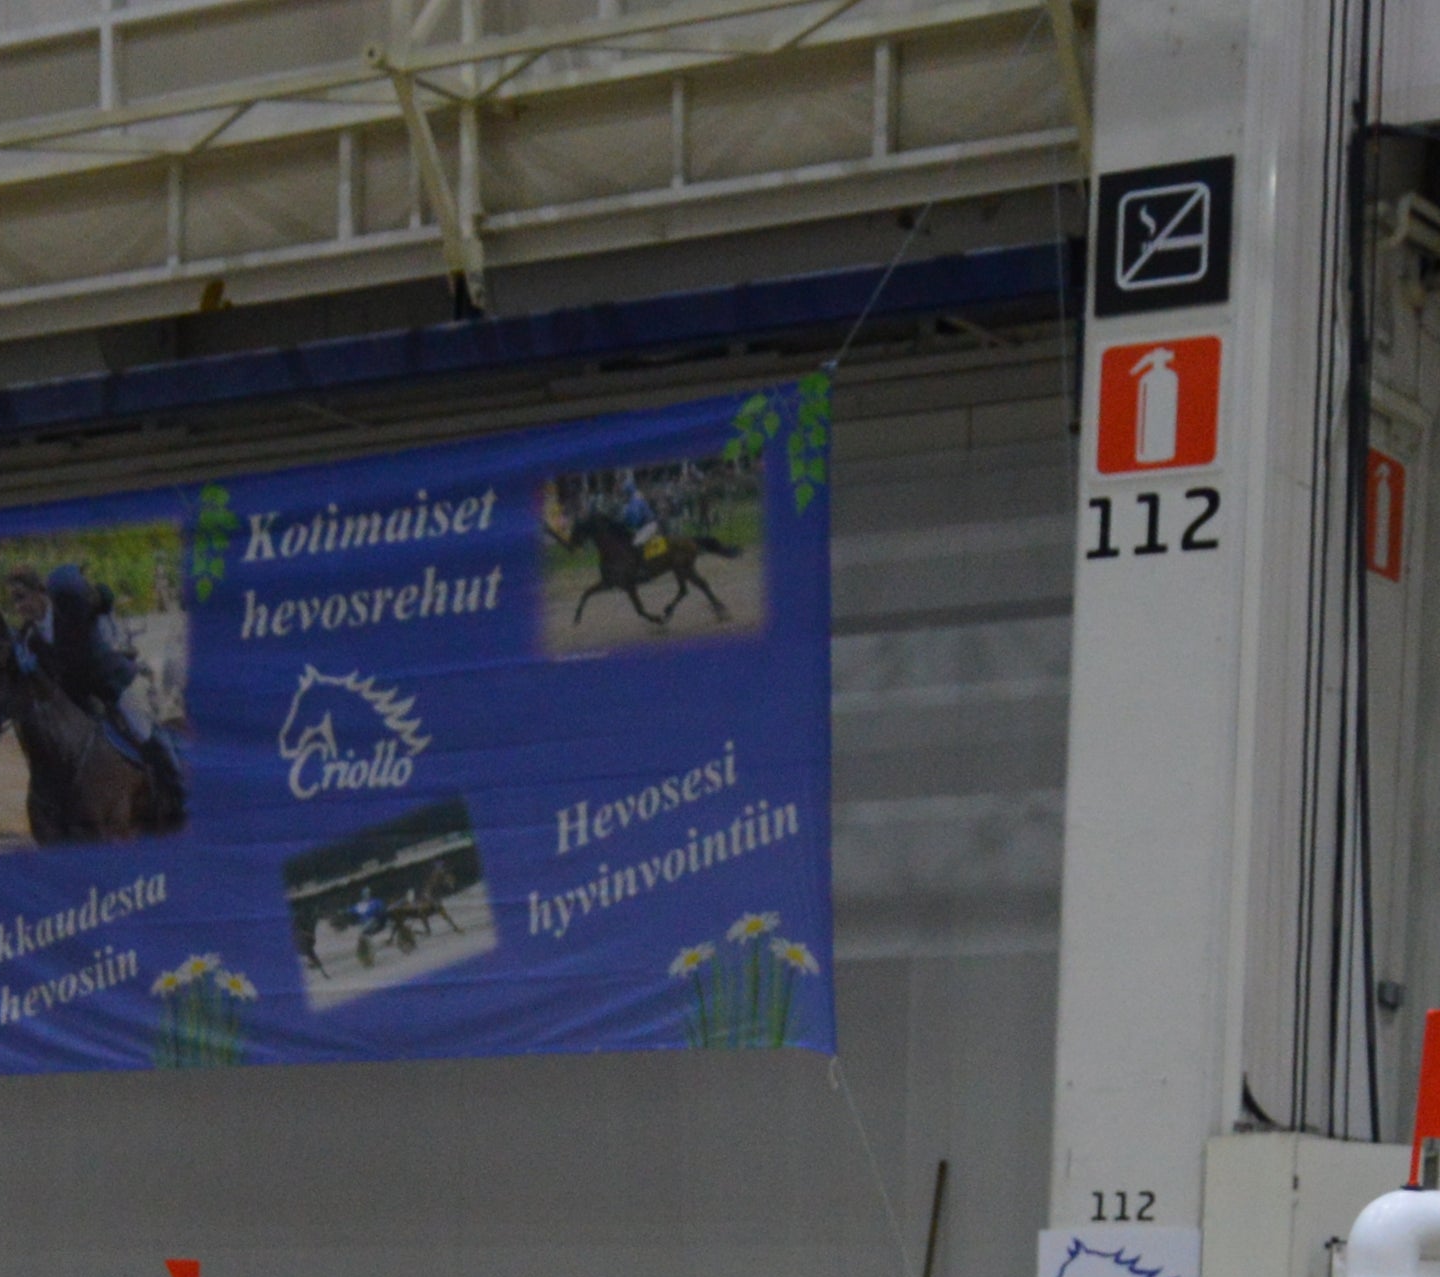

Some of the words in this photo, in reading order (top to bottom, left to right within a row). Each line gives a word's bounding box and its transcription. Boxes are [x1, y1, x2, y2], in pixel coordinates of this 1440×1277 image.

[242, 488, 498, 561] Kotimaiset
[1086, 487, 1220, 559] 112
[241, 564, 502, 640] hevosrehut
[289, 740, 413, 798] Criollo
[556, 740, 736, 855] Hevosesi
[528, 799, 799, 938] hyvinvointiin
[1091, 1190, 1156, 1221] 112
